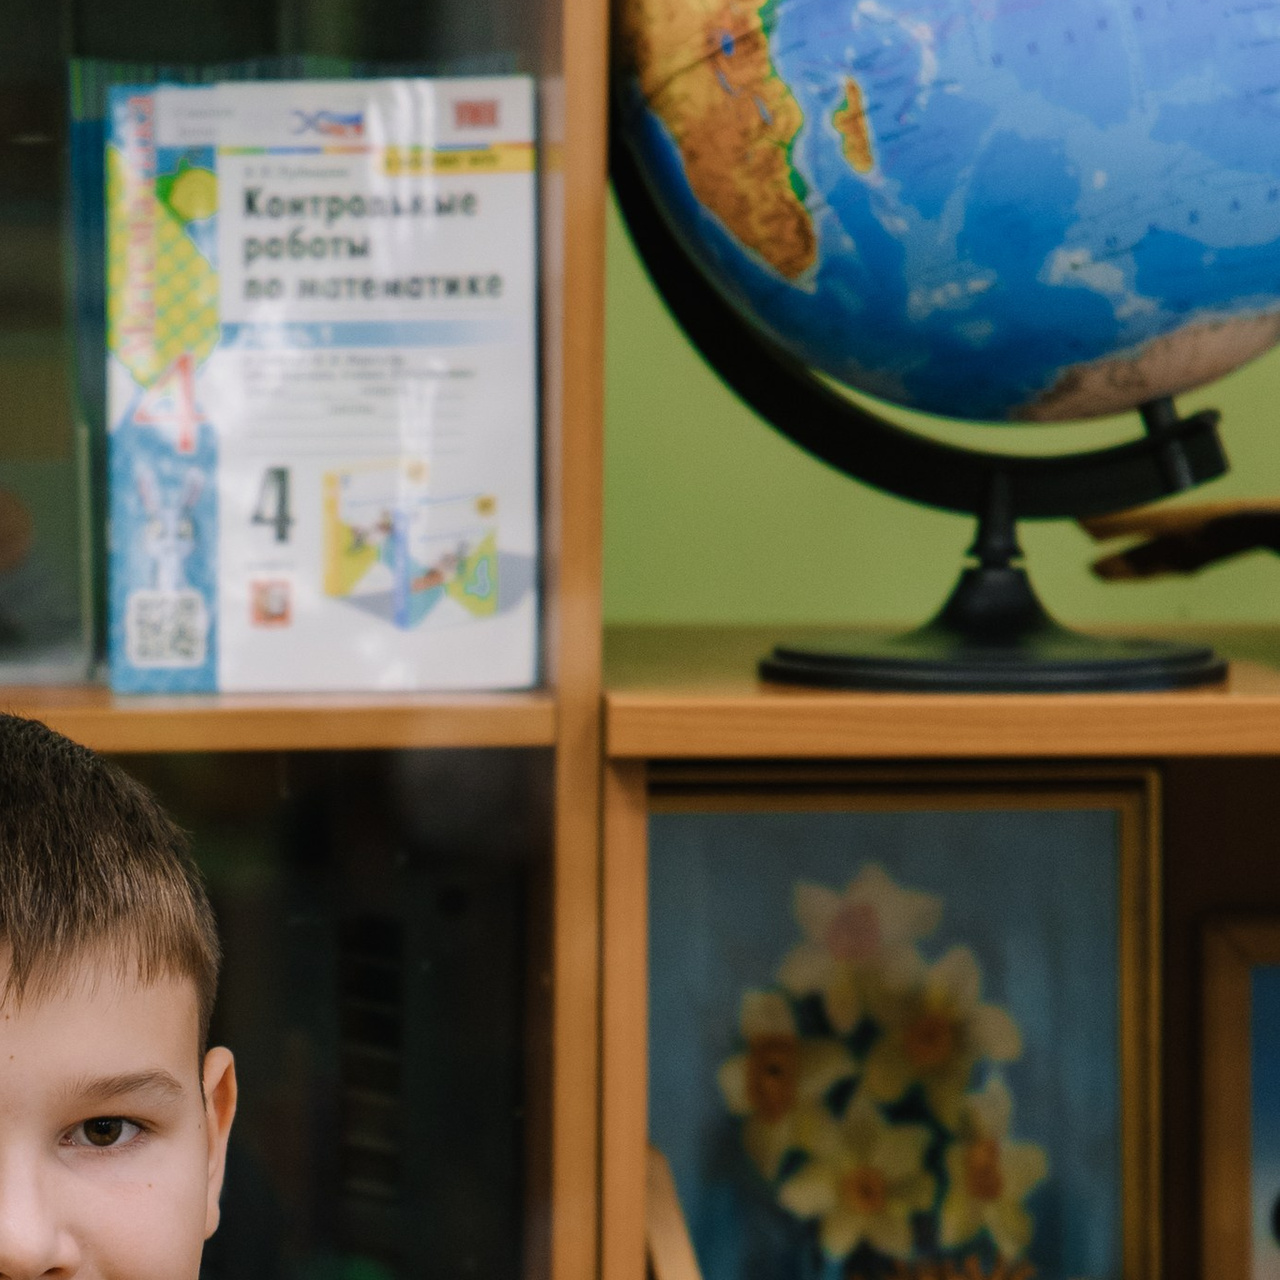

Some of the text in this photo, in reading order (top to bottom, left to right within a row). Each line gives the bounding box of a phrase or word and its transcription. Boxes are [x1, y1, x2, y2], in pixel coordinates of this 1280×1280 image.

[244, 226, 370, 265] работы
[244, 273, 504, 300] по математике
[250, 466, 295, 544] 4
